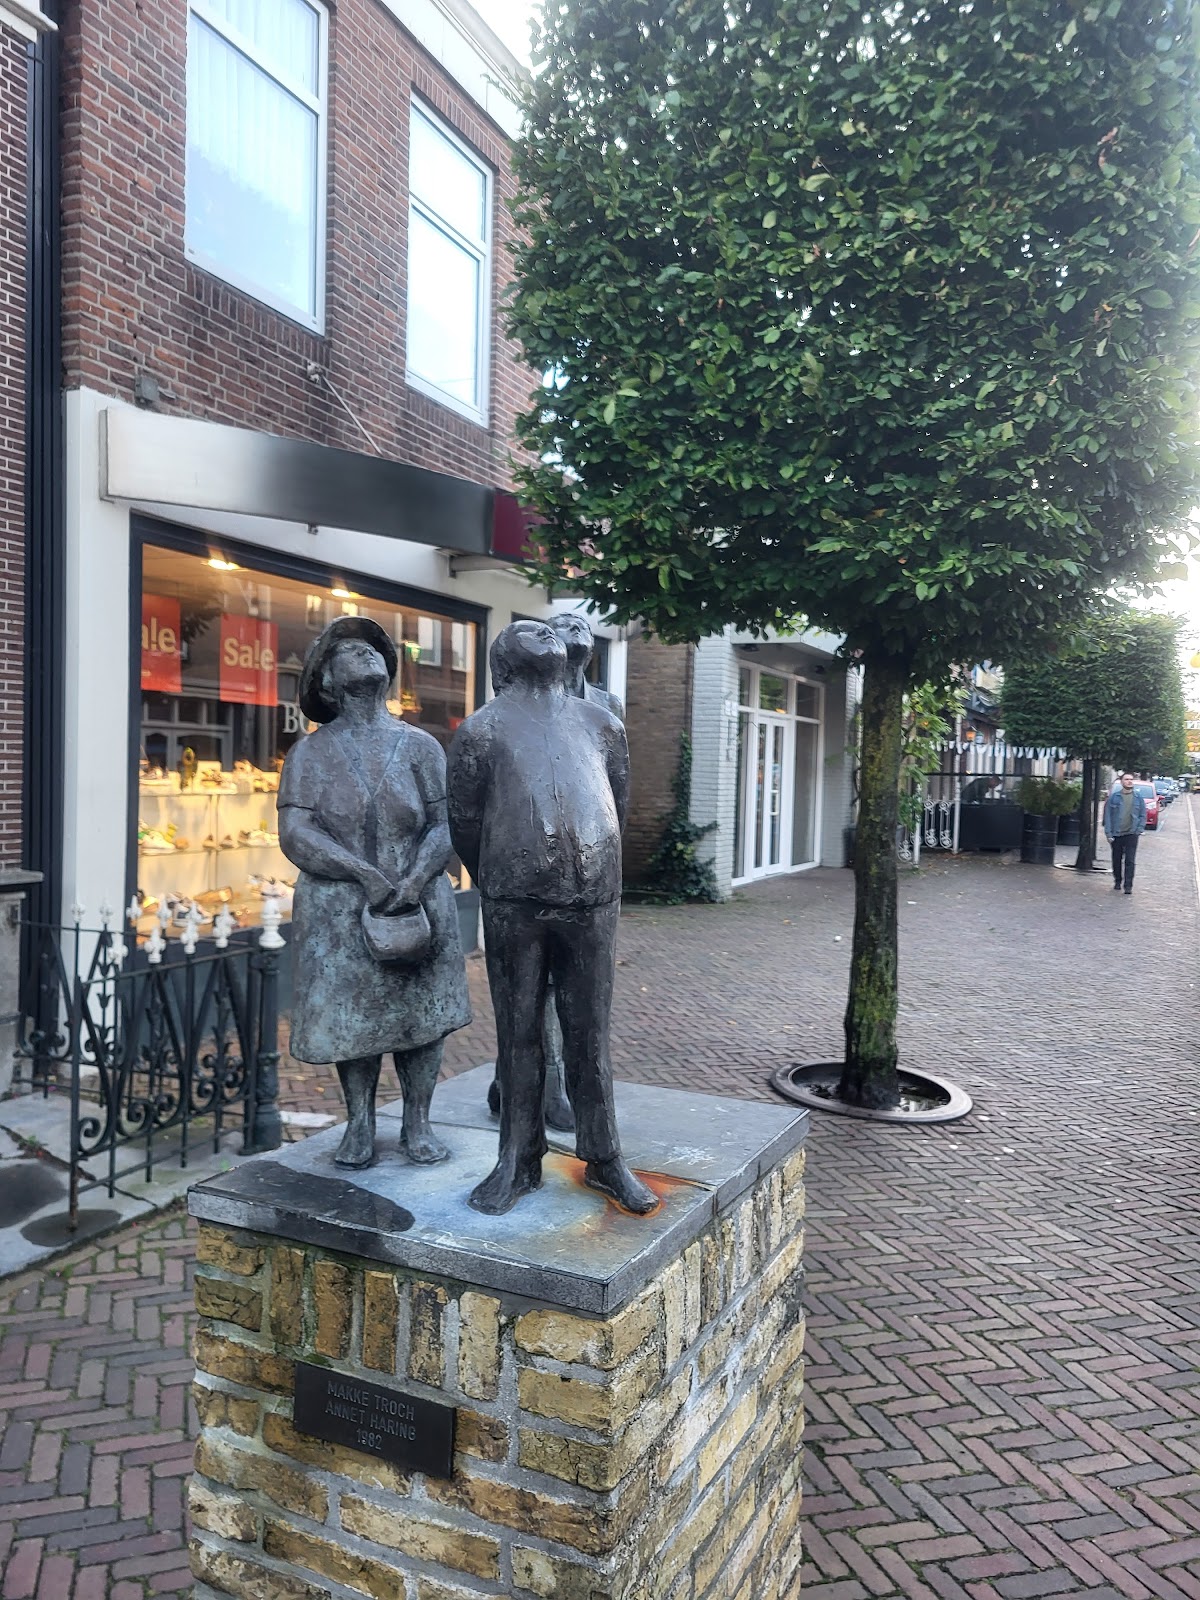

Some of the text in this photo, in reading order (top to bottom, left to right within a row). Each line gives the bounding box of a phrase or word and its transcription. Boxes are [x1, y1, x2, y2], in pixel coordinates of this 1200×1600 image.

[327, 1380, 415, 1421] MAKKE TROCH
[325, 1401, 416, 1441] ANNET HARING
[356, 1428, 383, 1450] 1982
